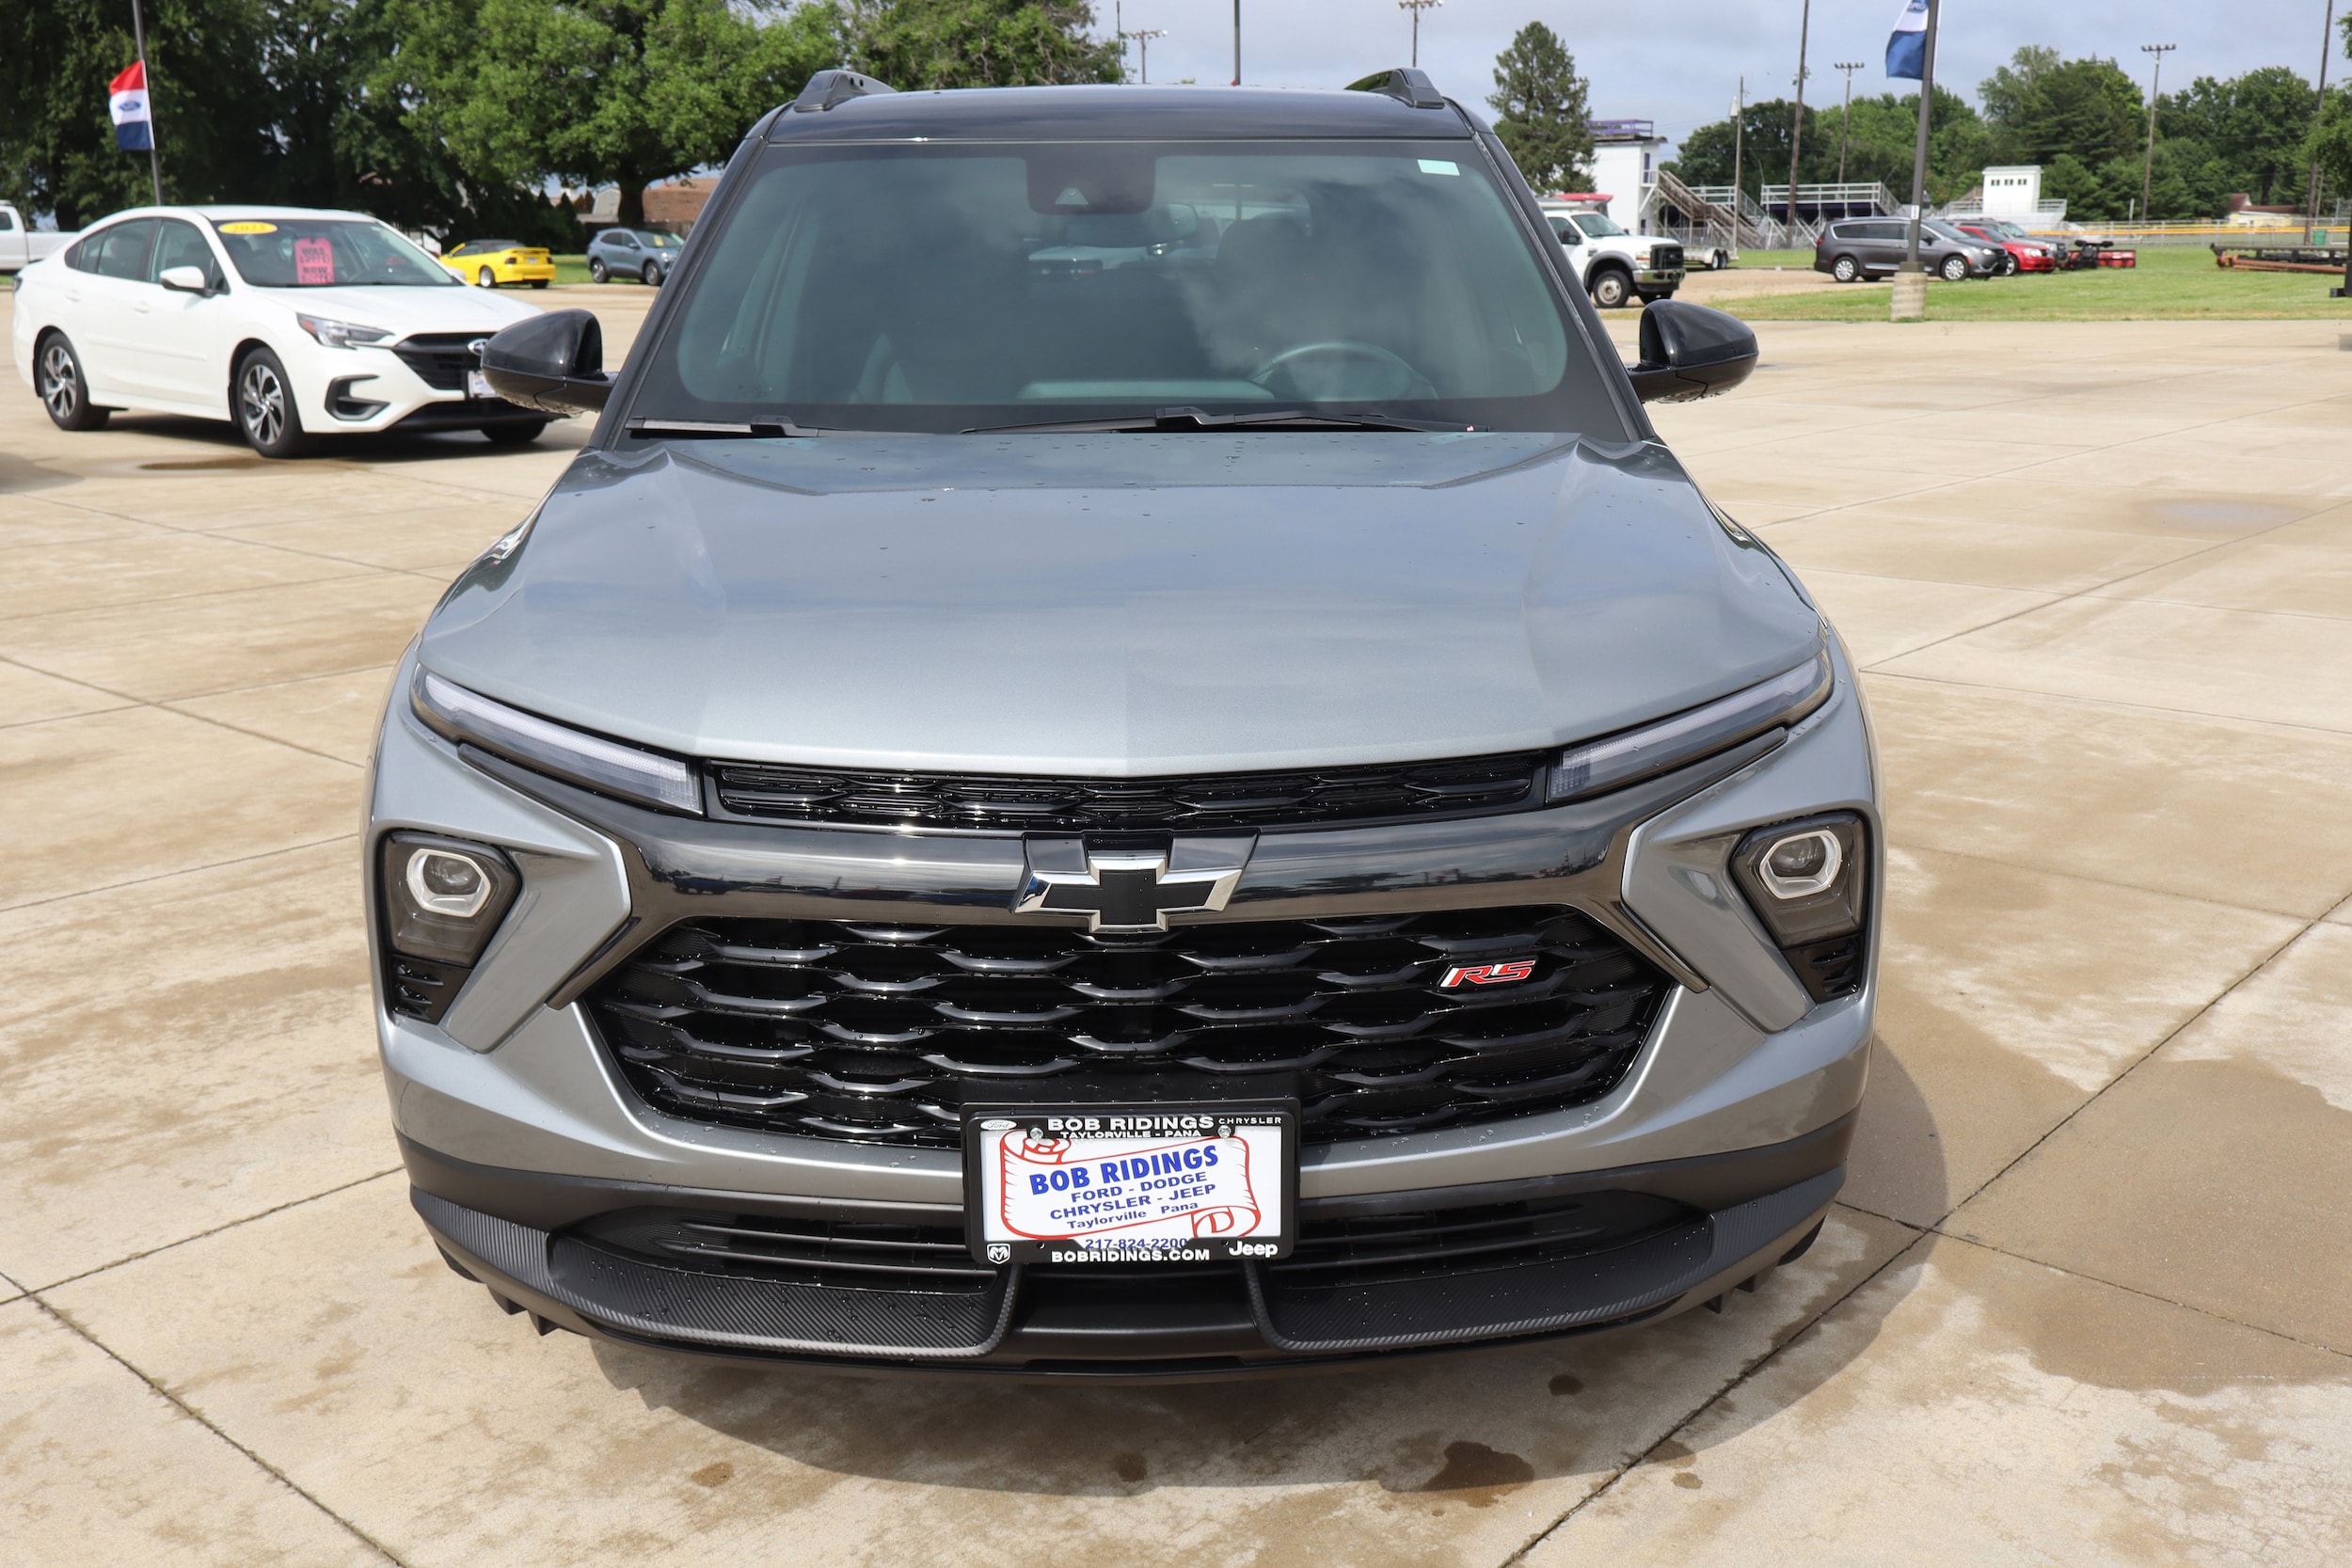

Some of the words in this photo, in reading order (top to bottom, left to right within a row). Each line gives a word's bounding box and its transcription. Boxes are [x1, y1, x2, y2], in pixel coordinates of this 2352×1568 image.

[1440, 960, 1535, 987] RS
[1048, 1117, 1101, 1132] BOB
[1110, 1116, 1214, 1131] RIDINGS
[1218, 1117, 1281, 1125] CHRYSLER
[1060, 1131, 1151, 1139] TAYLORVILLE
[1165, 1130, 1201, 1138] PANA
[1029, 1167, 1090, 1196] BOB
[1101, 1145, 1218, 1183] RIDINGS
[1071, 1185, 1122, 1203] FORD
[1140, 1172, 1208, 1192] DODGE
[1050, 1195, 1152, 1220] CHRYSLER
[1168, 1183, 1216, 1200] JEEP
[1067, 1210, 1147, 1229] Taylorville
[1161, 1202, 1199, 1214] Pana
[1085, 1238, 1188, 1249] 217-824-2200
[1229, 1240, 1279, 1259] Jeep
[1051, 1248, 1210, 1263] BOBRIDINGS.COM
